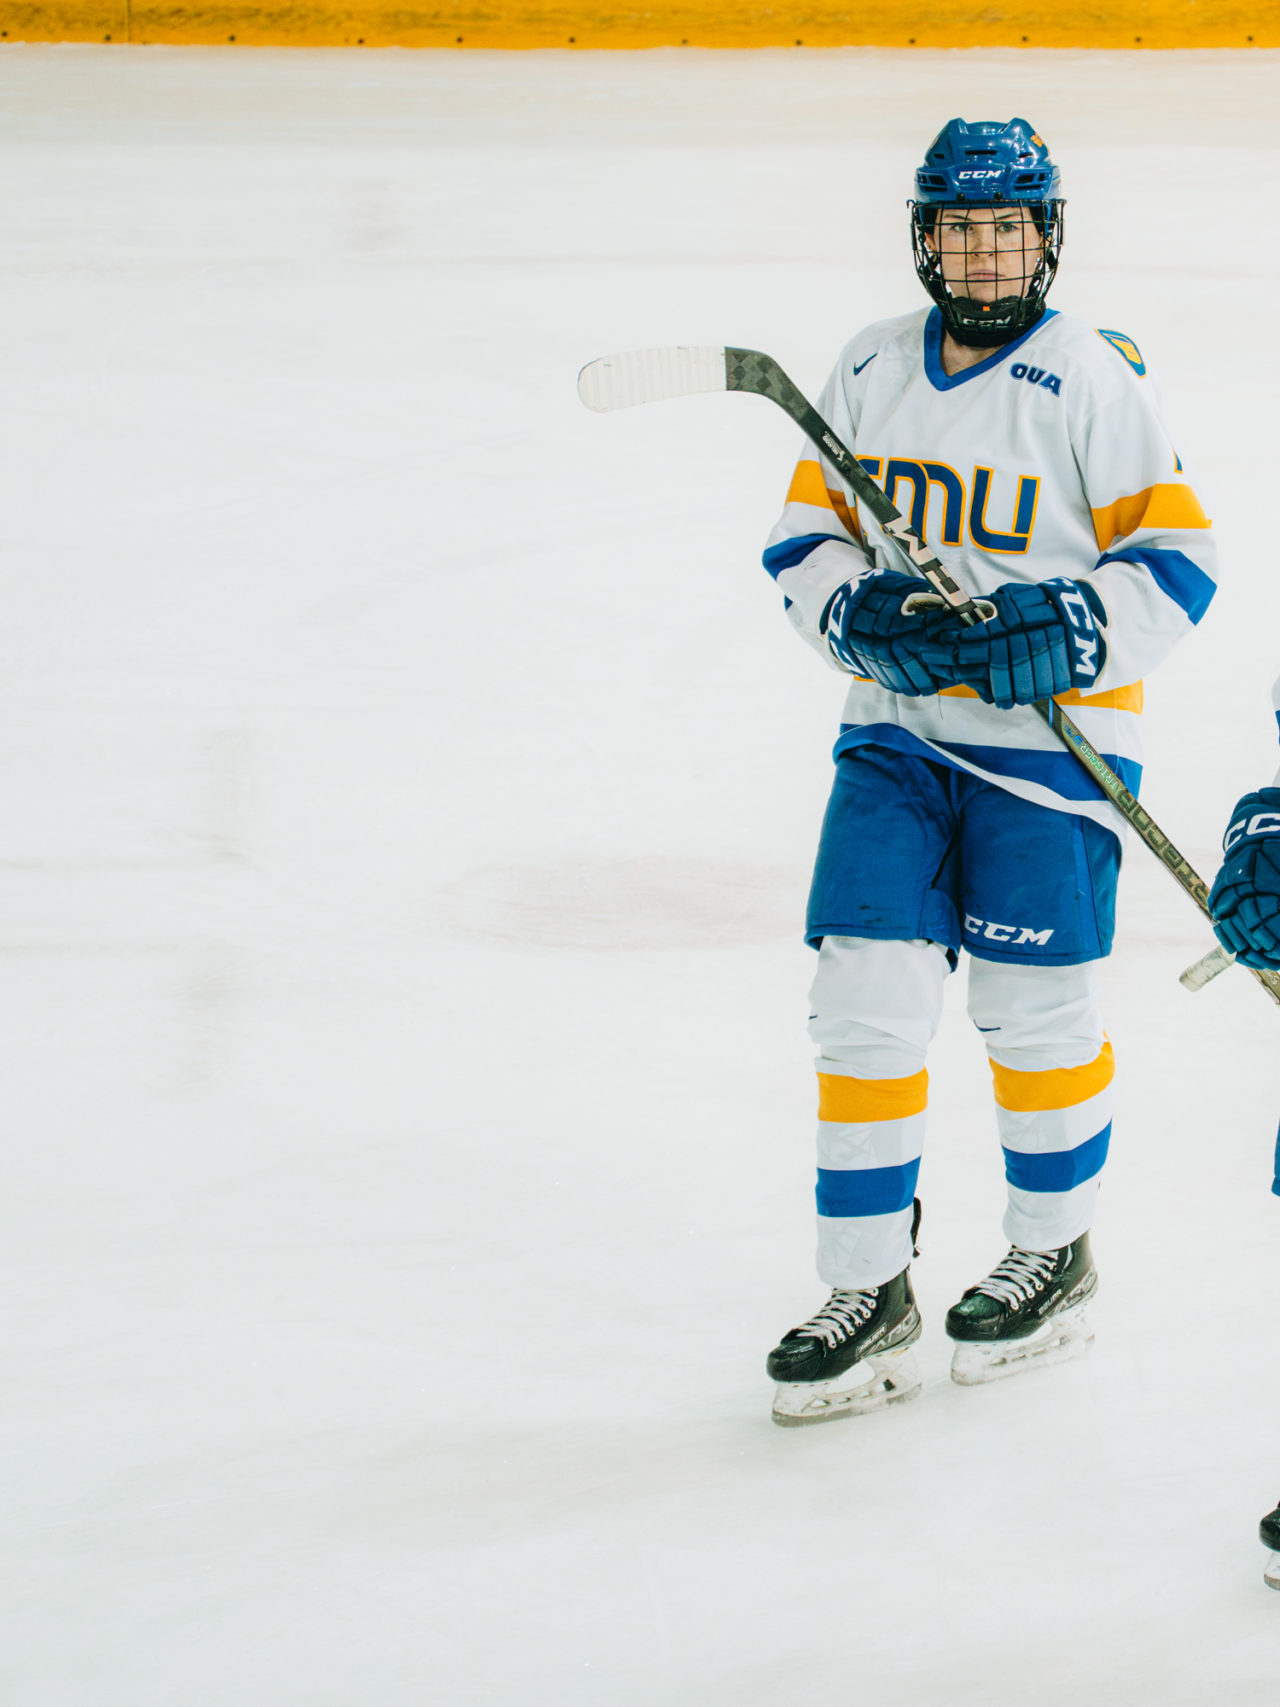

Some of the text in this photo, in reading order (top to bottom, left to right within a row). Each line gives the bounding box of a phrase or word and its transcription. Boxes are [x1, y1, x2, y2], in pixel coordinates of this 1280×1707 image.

[958, 170, 1001, 180] CCM
[1010, 361, 1063, 398] OUA
[963, 912, 1055, 946] CCM
